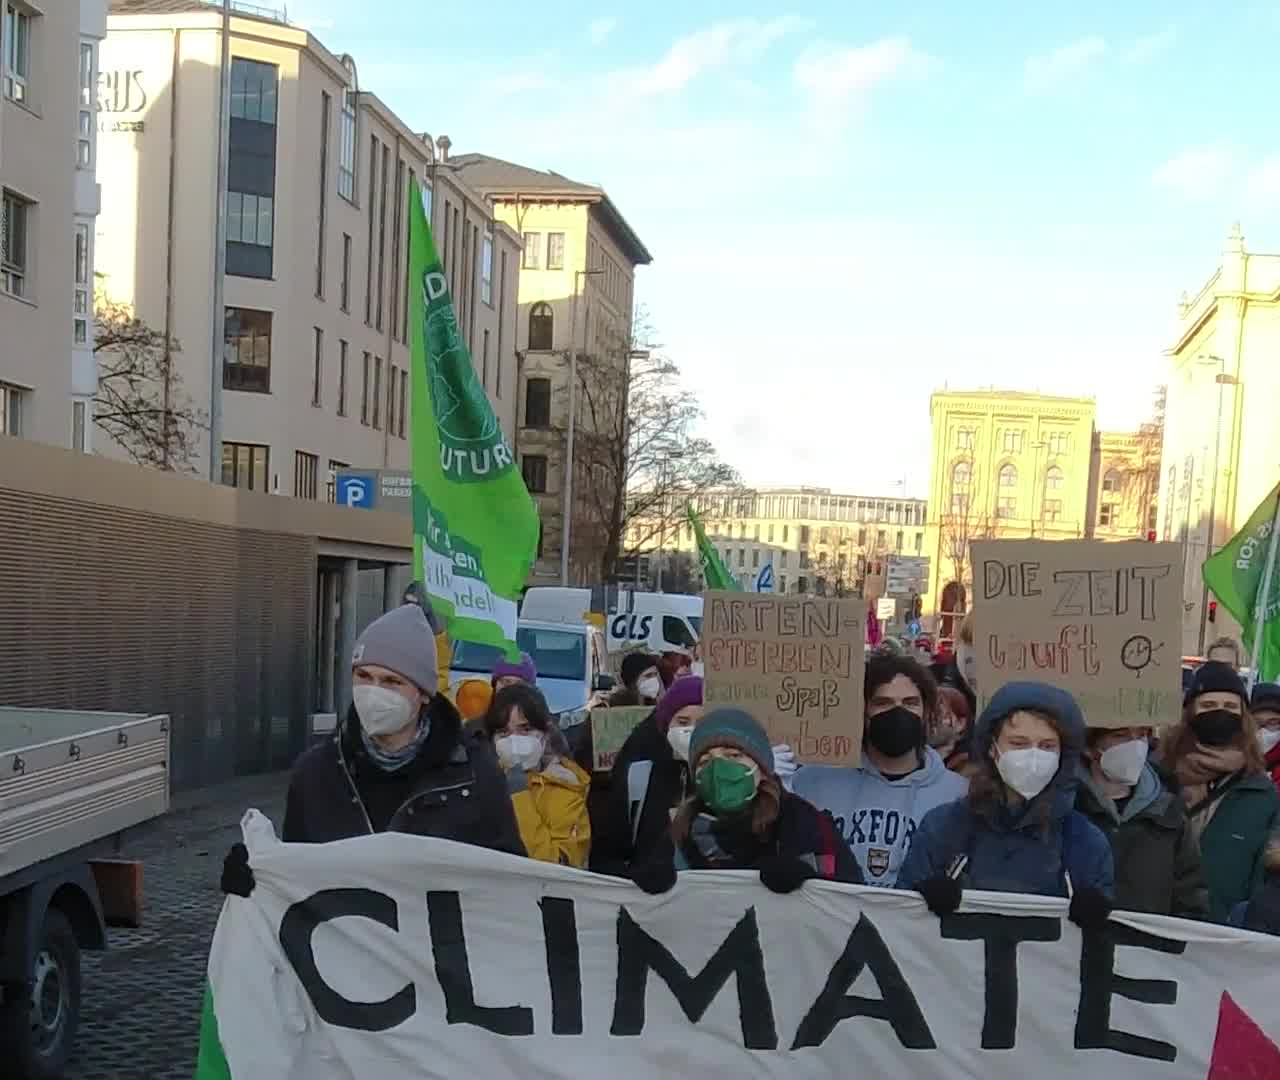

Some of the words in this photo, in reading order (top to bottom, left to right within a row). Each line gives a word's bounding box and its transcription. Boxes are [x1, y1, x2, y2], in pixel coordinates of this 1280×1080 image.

[983, 559, 1042, 600] DIE
[1051, 564, 1170, 622] ZEIT
[611, 614, 653, 640] GLS
[278, 886, 1189, 1063] CLIMATE
